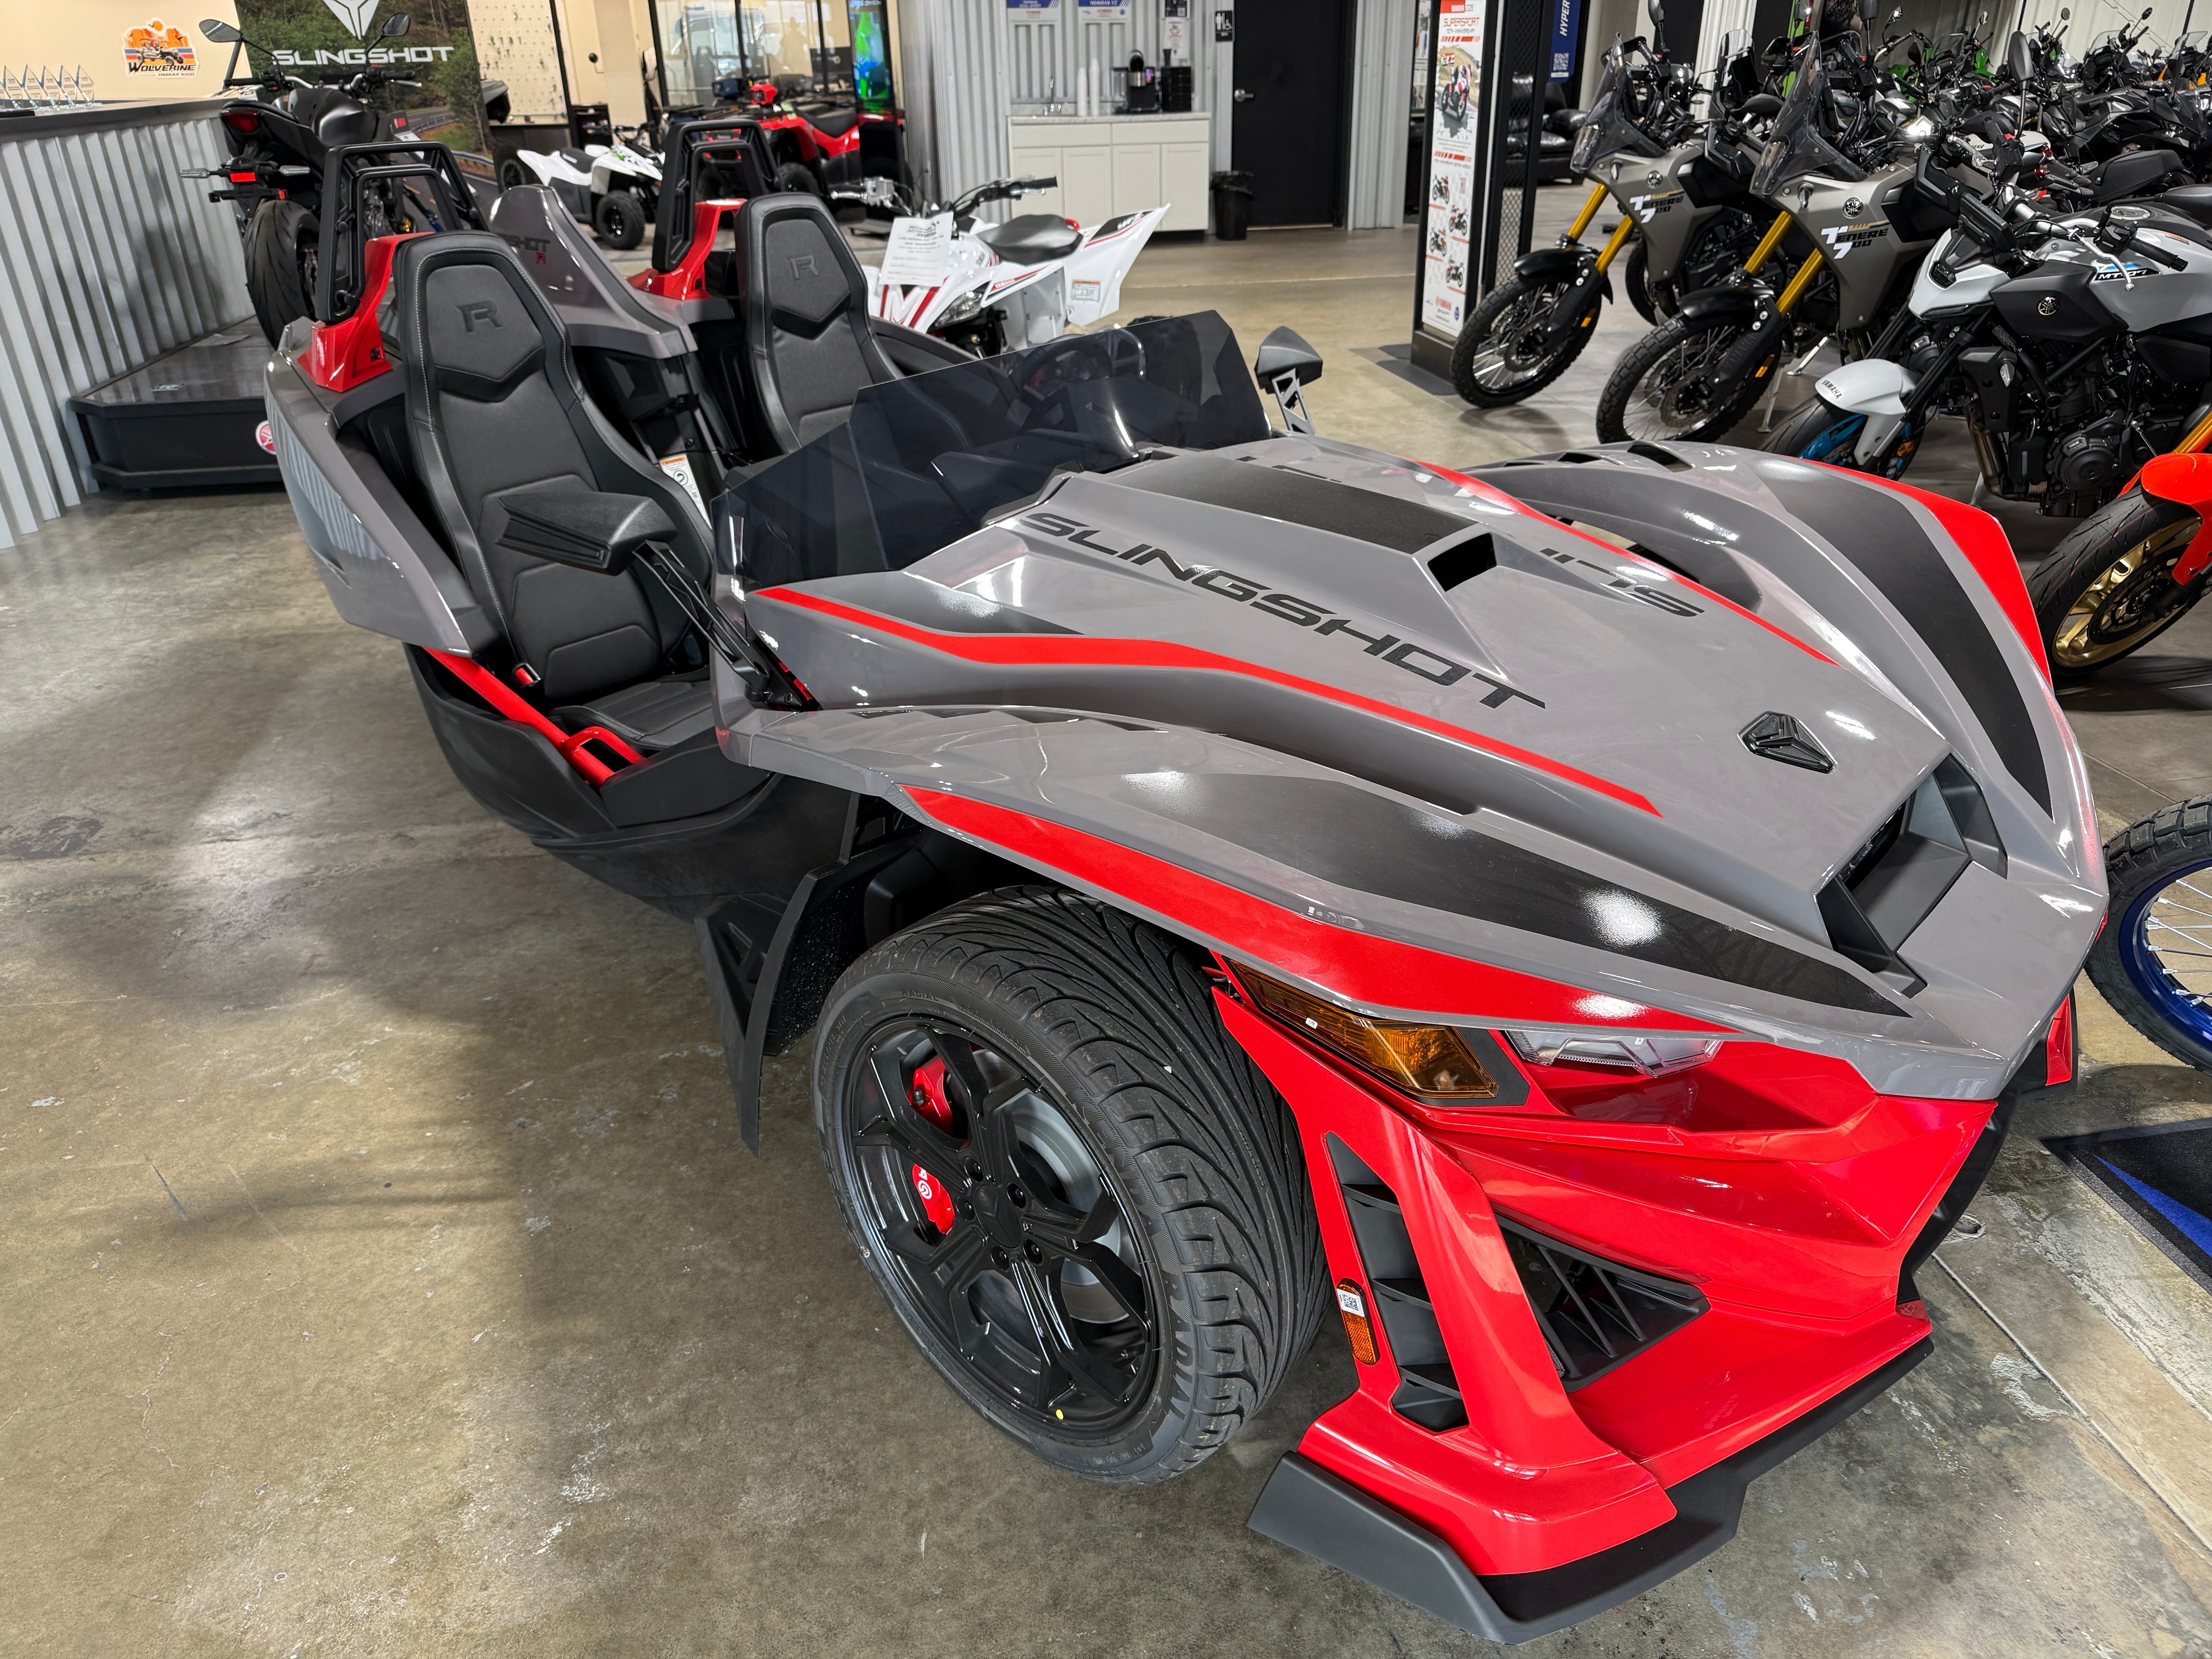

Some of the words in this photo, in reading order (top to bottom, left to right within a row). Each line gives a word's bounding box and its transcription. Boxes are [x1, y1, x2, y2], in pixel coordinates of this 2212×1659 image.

[1443, 17, 1480, 27] SUPERSPORT
[1559, 0, 1570, 36] HYPER
[272, 46, 454, 65] SLINGSHOT
[129, 62, 195, 72] WOLVERINE
[1640, 206, 1671, 224] 700
[1821, 226, 1889, 244] TENERE
[536, 252, 546, 264] R
[1833, 239, 1872, 259] 700
[785, 255, 821, 280] R
[456, 301, 504, 333] R
[1821, 379, 1842, 399] YAMAHA
[1019, 512, 1546, 710] SLINGSHOT
[902, 989, 939, 1002] RADIAL
[1066, 1087, 1163, 1237] KENDA
[1161, 1269, 1195, 1420] RADIAL
